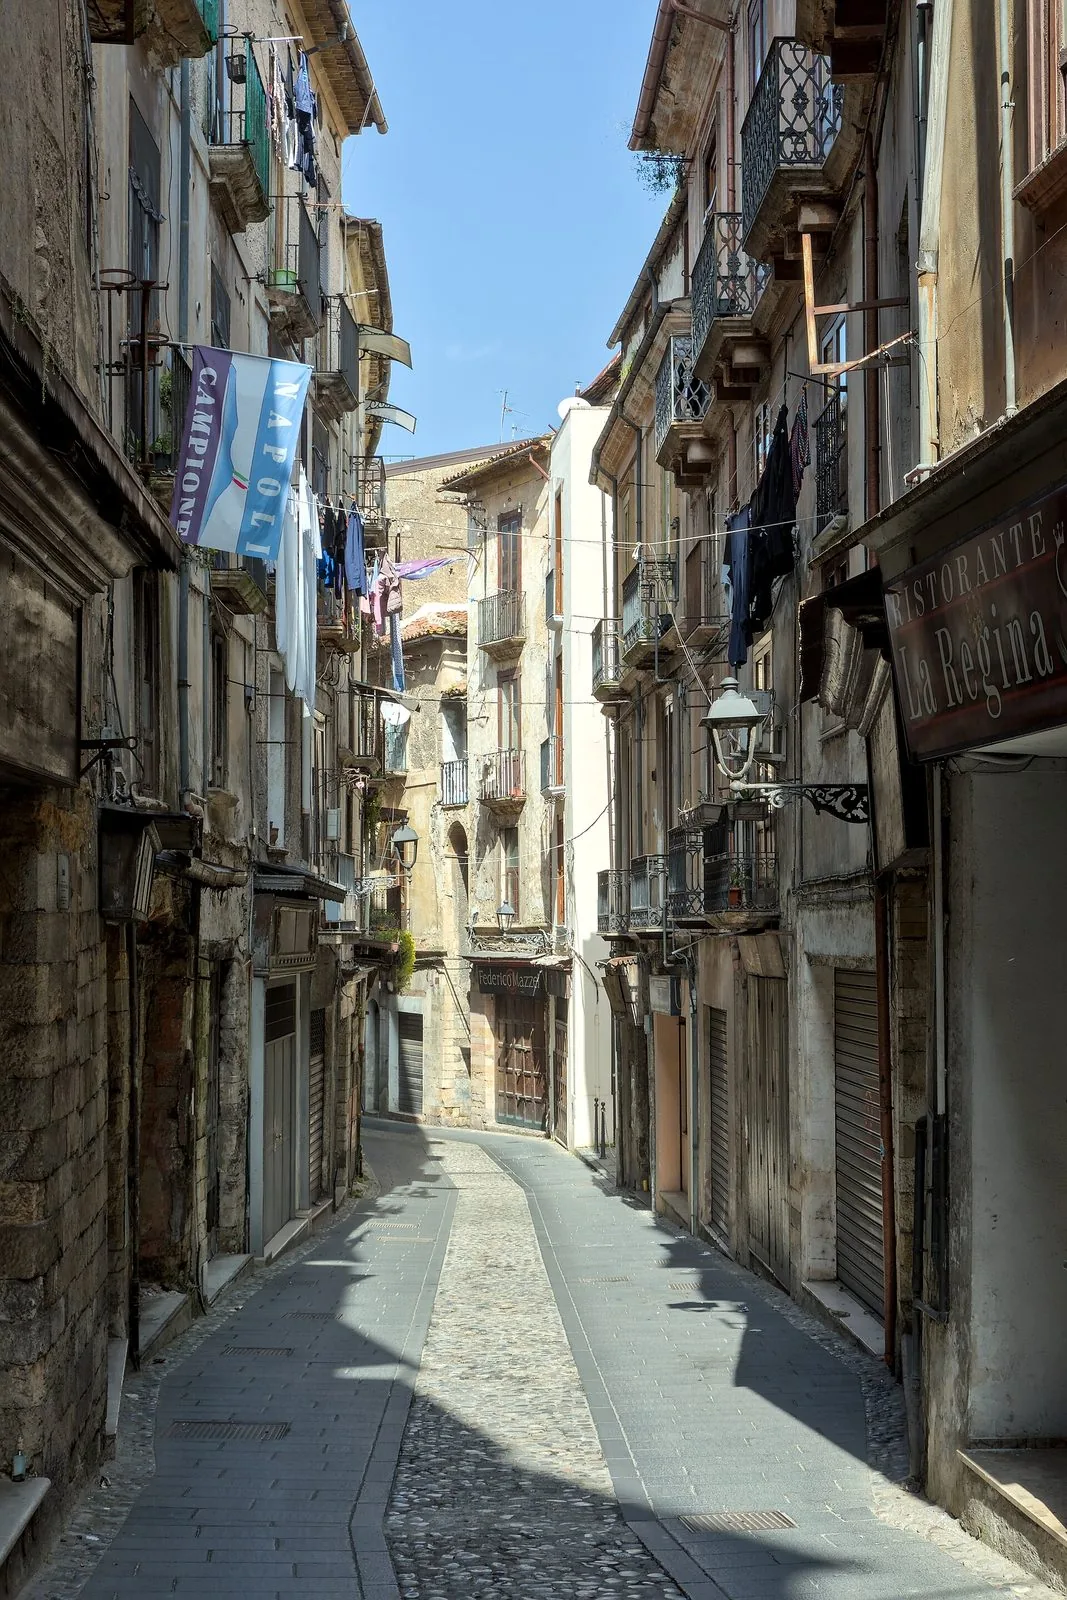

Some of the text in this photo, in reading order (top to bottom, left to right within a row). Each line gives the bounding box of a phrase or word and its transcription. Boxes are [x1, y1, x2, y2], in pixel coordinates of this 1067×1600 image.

[177, 367, 217, 536] CAMPIONE
[245, 381, 300, 556] NAPOLI
[891, 511, 1047, 629] RISTORANTE
[899, 603, 1054, 721] La Regina
[479, 969, 511, 987] Federico
